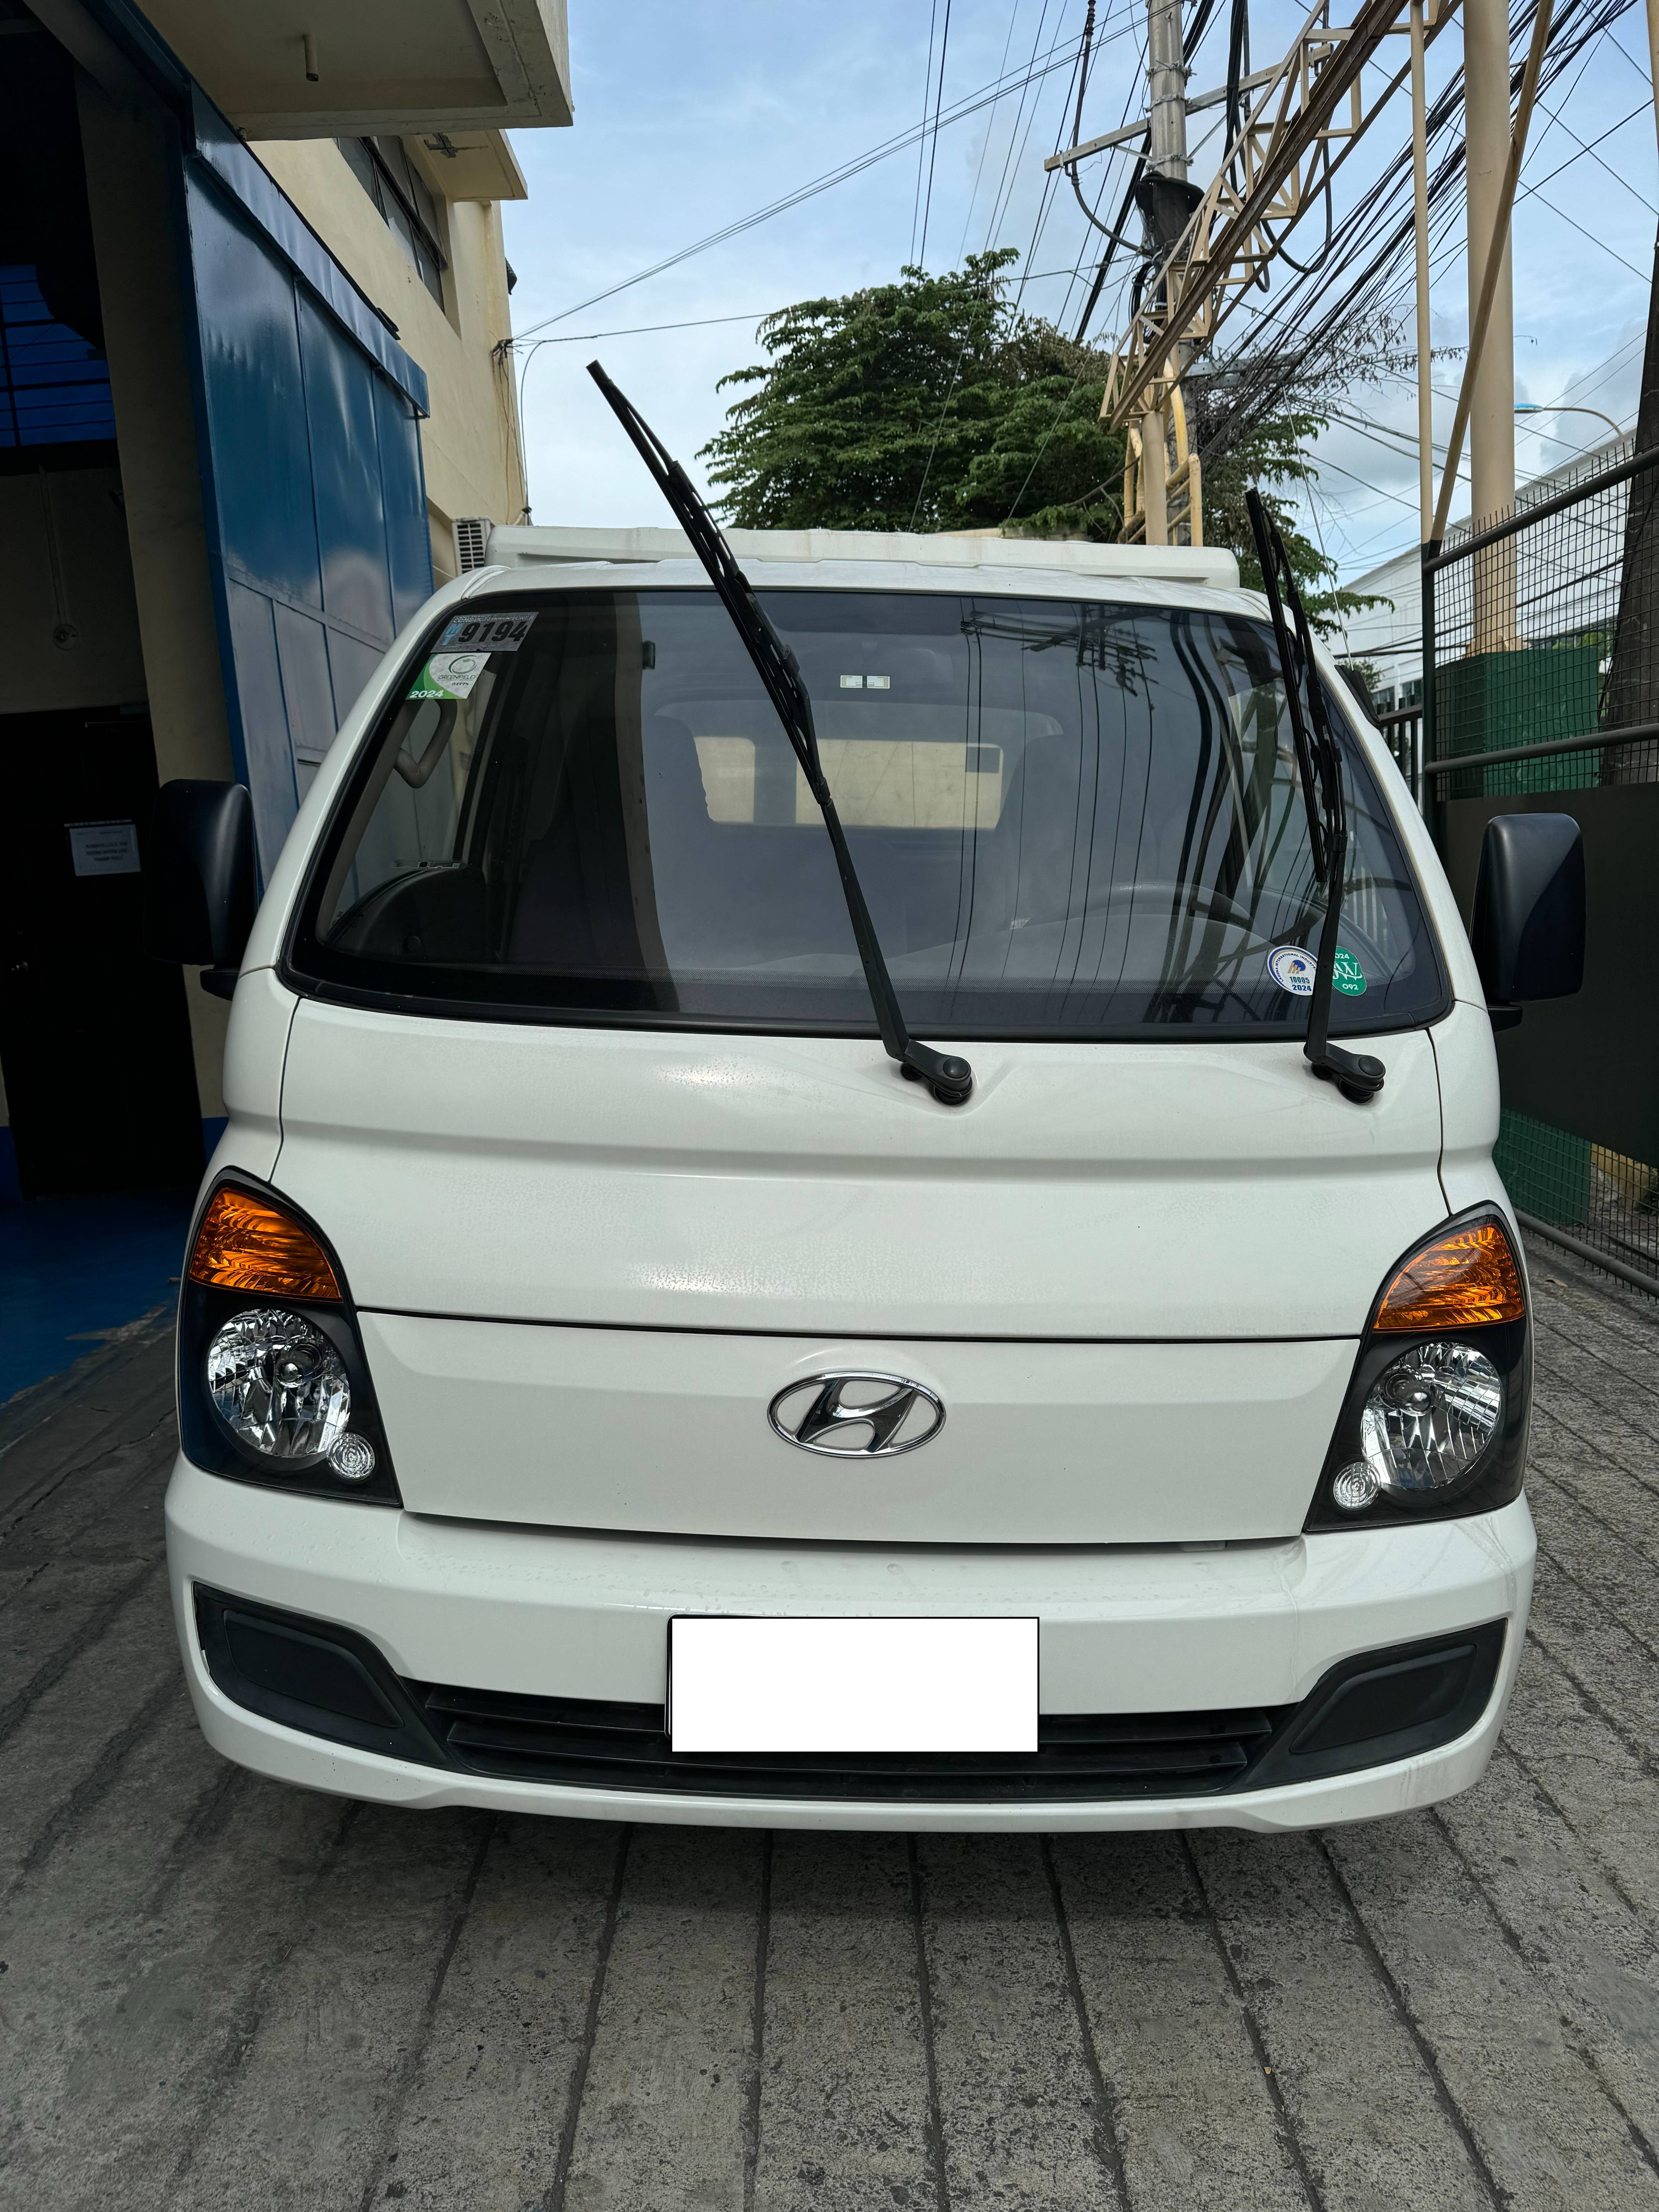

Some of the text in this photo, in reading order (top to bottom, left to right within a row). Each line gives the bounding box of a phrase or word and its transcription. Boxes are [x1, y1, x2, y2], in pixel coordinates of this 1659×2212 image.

[458, 621, 528, 643] 9194
[409, 690, 443, 698] 2024
[1275, 953, 1299, 967] INTERNATIONAL
[1275, 967, 1284, 982] LAGUNA
